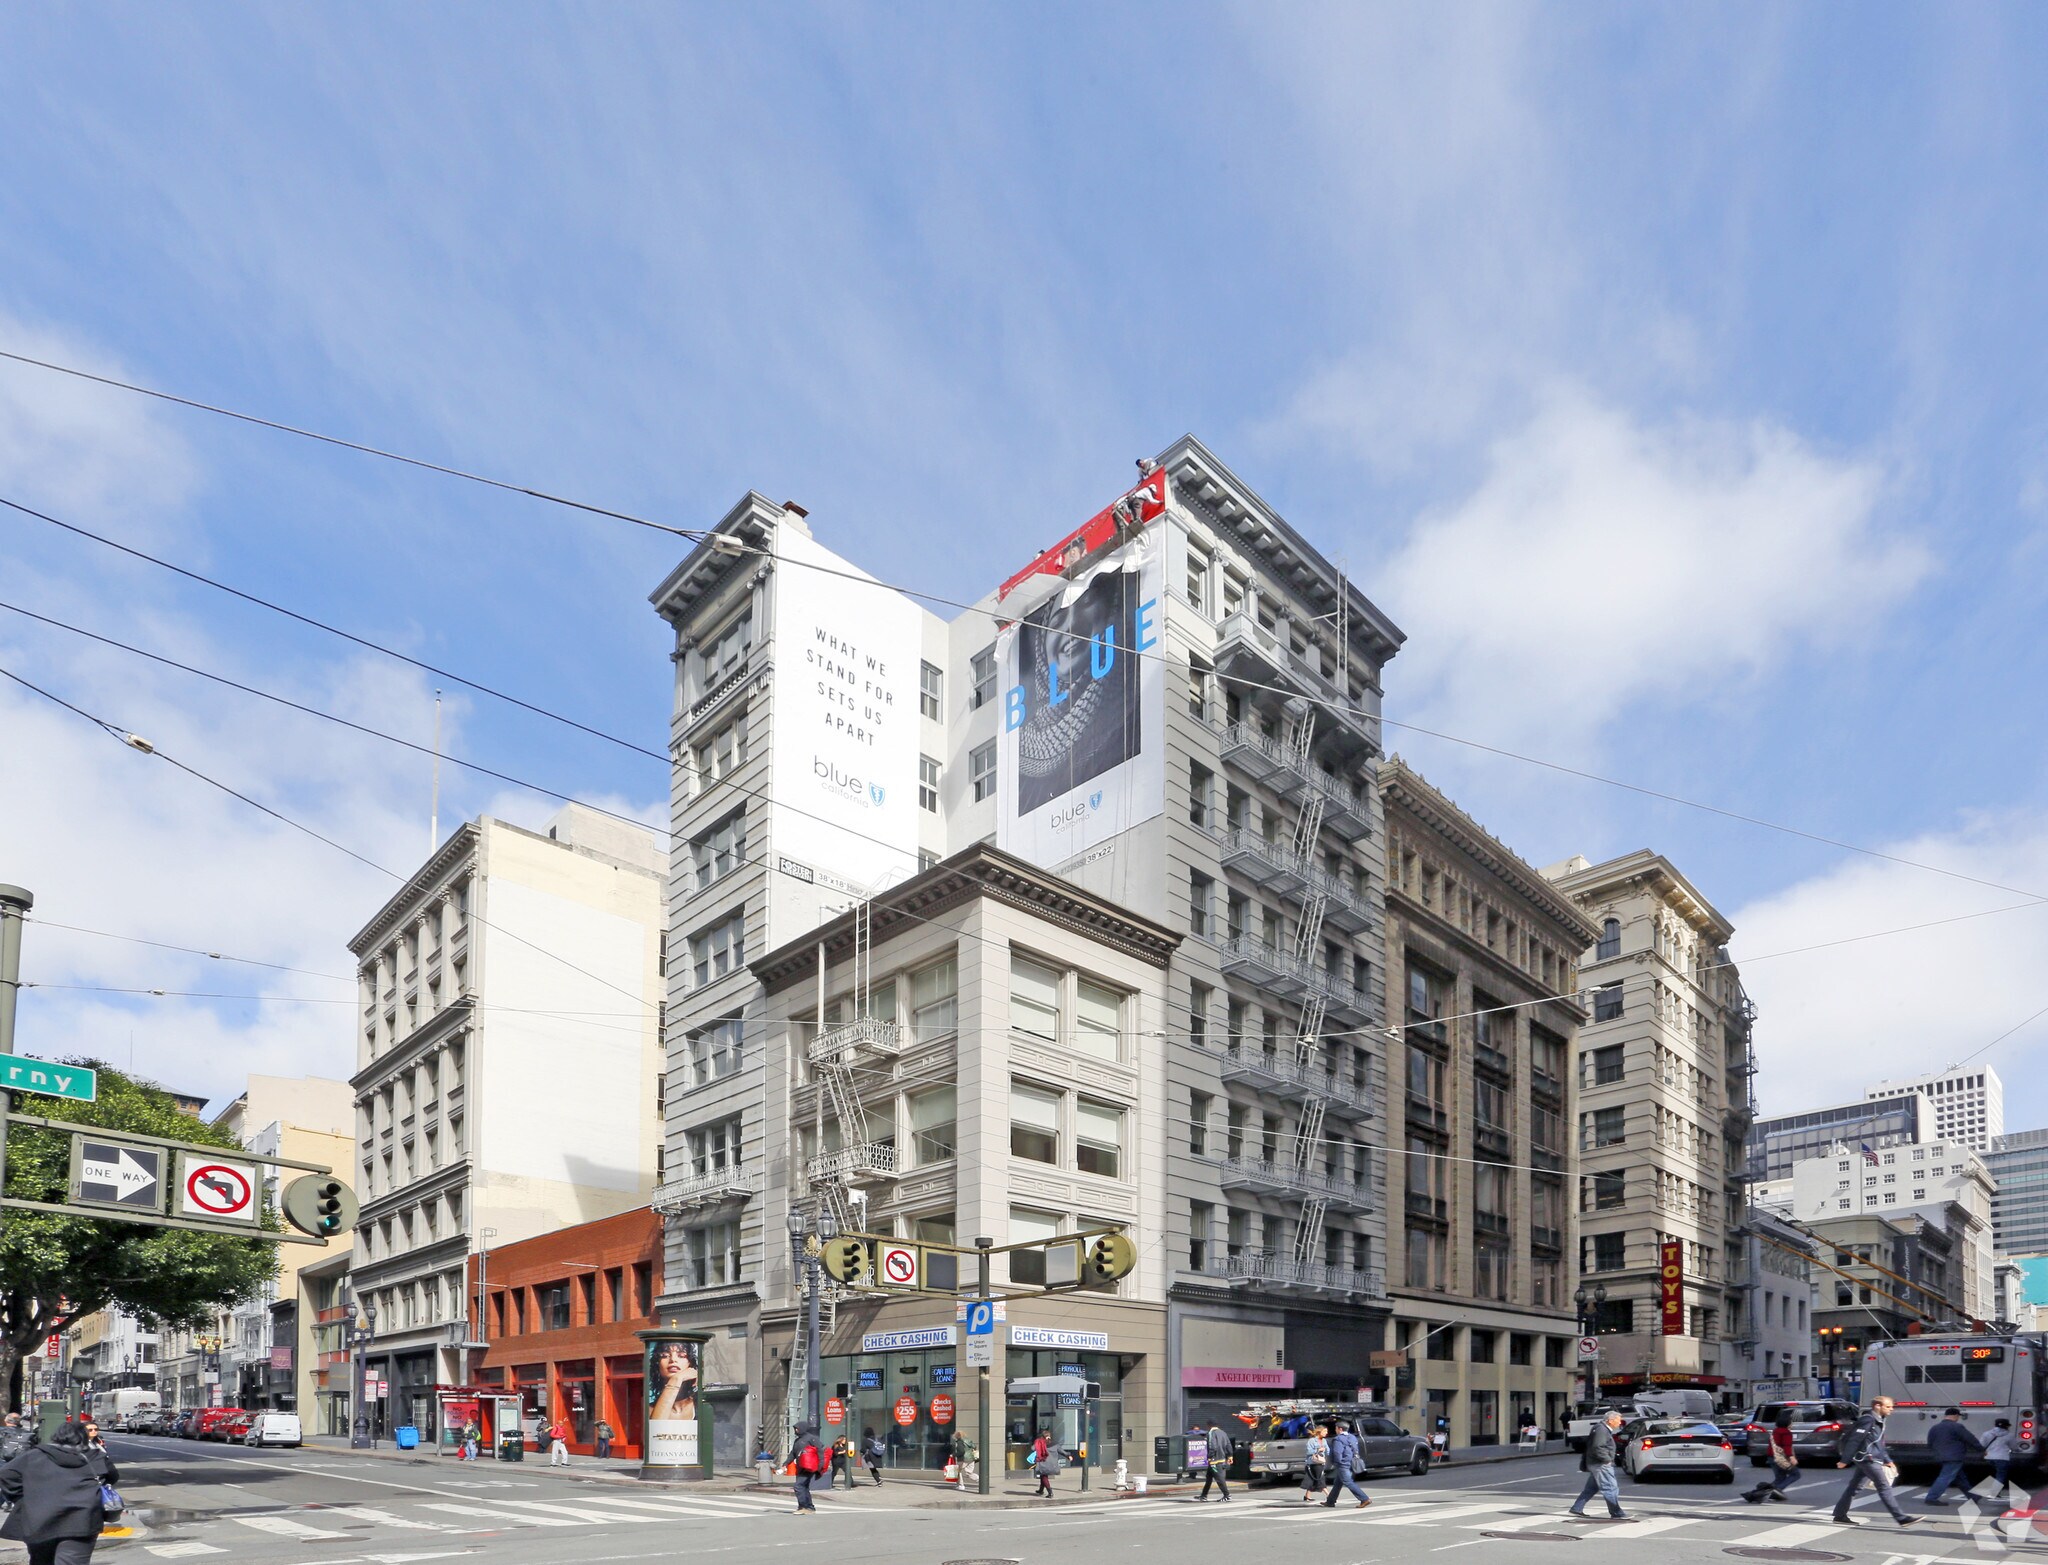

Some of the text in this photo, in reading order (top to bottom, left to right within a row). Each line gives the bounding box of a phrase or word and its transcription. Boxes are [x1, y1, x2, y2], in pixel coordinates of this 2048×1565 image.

[815, 626, 886, 677] WHAT WE
[1006, 597, 1157, 734] BLUE
[806, 648, 893, 706] STAND FOR
[817, 681, 882, 725] SETS US
[825, 712, 874, 746] APART
[814, 754, 862, 794] blue
[821, 781, 869, 809] california
[1050, 803, 1086, 829] blue
[1055, 813, 1090, 835] california
[85, 1166, 149, 1184] ONE WAY
[1663, 1247, 1680, 1315] TOYS
[864, 1330, 948, 1348] CHECK CASHING
[1014, 1330, 1106, 1347] CHECK CASHING
[860, 1372, 879, 1380] PAYROLL
[933, 1367, 944, 1375] CAR
[936, 1374, 954, 1383] LOANS
[1061, 1365, 1083, 1374] PAYROLL
[1215, 1372, 1283, 1384] ANGELIC PRETTY
[896, 1405, 915, 1416] $255
[1063, 1397, 1081, 1405] LOANS
